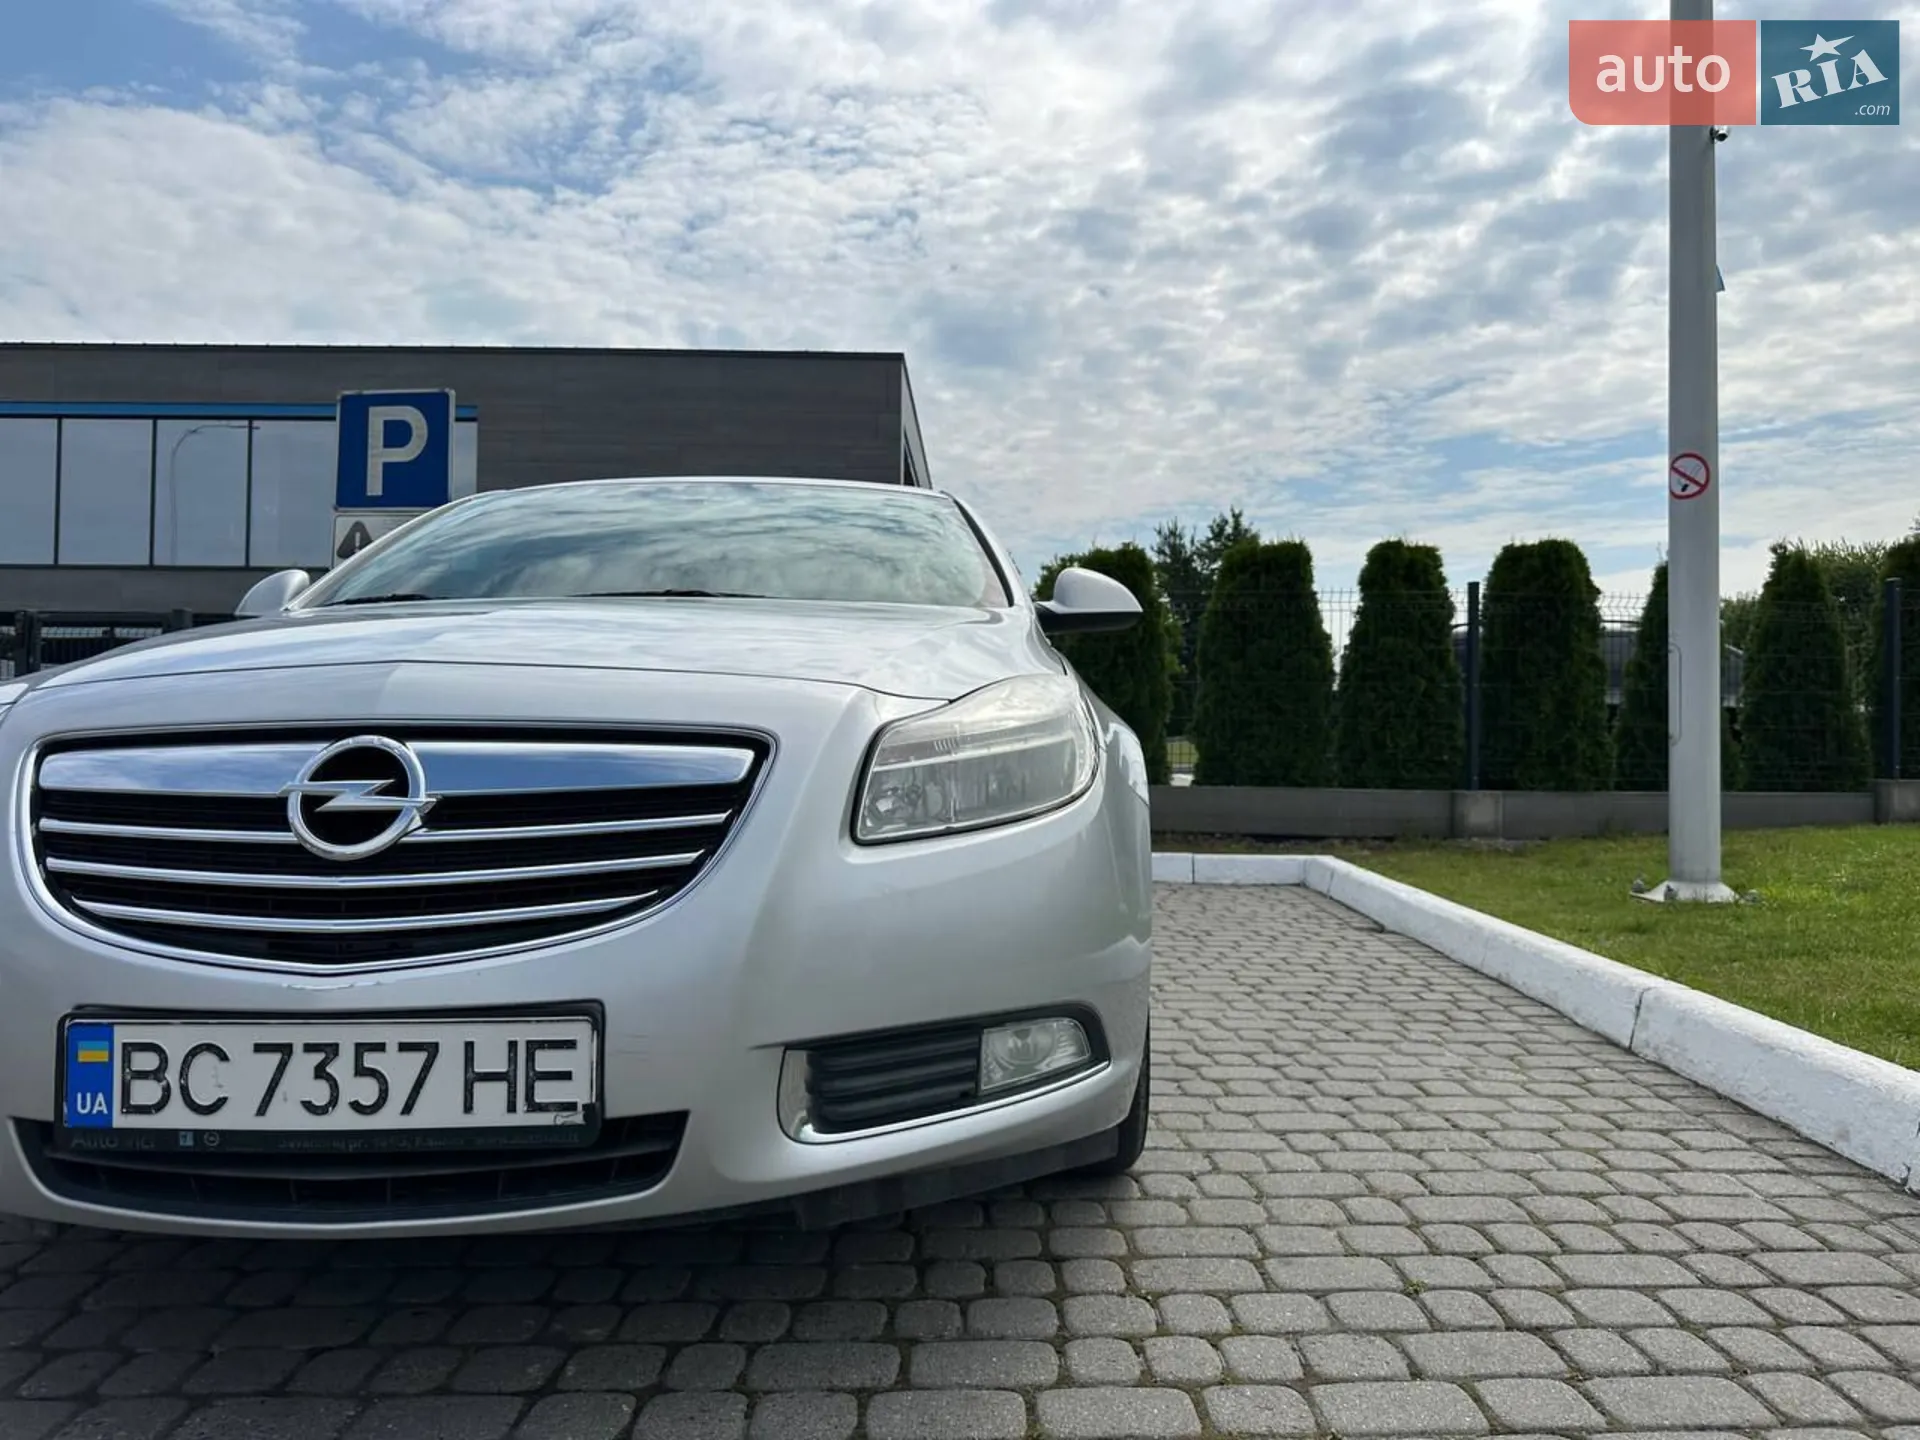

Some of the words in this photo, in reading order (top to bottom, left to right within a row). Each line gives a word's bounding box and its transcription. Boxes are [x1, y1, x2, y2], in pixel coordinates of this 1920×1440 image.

[366, 405, 428, 496] P
[76, 1092, 109, 1115] UA
[121, 1042, 230, 1116] BC
[253, 1041, 440, 1117] 7357
[463, 1039, 578, 1114] HE
